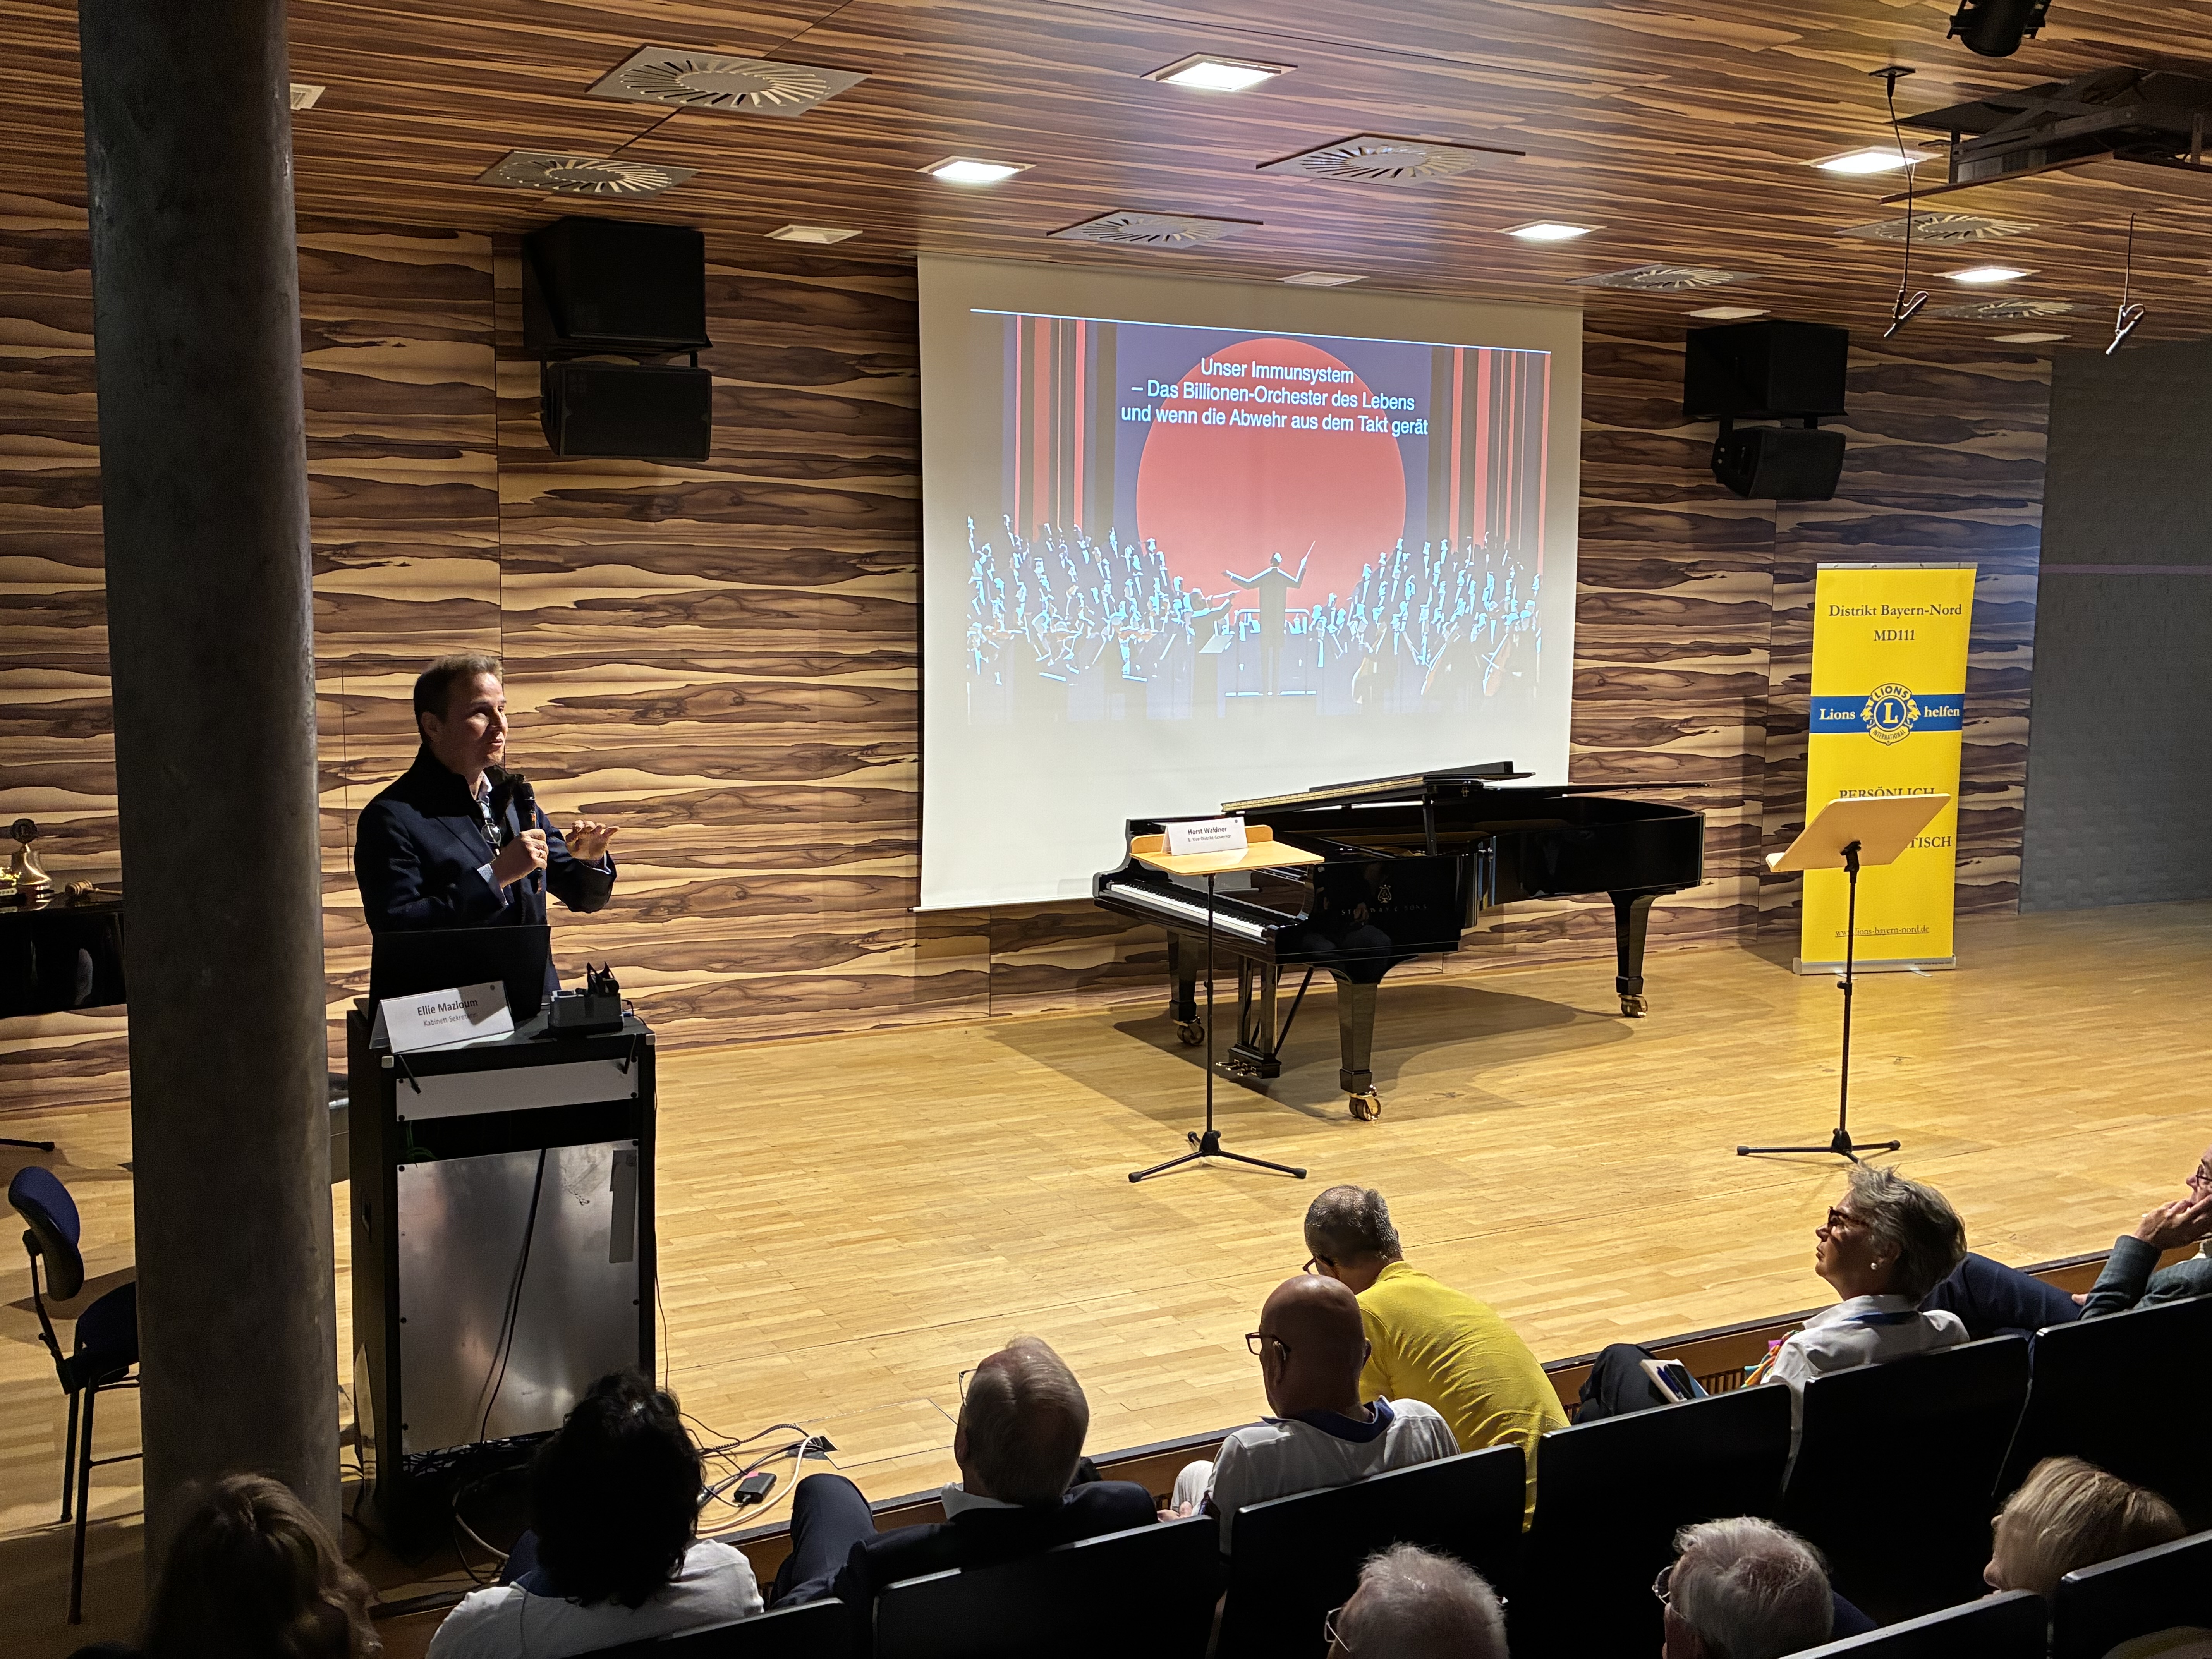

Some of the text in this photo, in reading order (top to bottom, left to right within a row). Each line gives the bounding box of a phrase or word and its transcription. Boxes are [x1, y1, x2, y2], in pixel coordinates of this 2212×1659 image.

[1201, 357, 1354, 385] Unser Immunsystem
[1147, 380, 1179, 398] Das
[1183, 381, 1328, 406] Billionen-Orchester
[1331, 390, 1358, 407] des
[1362, 392, 1415, 411] Lebens
[1121, 404, 1429, 437] und wenn die Abwehr aus dem Takt gerät
[1829, 604, 1962, 619] Distrikt Bayern-Nord
[1874, 629, 1915, 641] MD111
[1874, 685, 1909, 697] LIONS
[1819, 706, 1960, 720] Lions helfen
[1883, 702, 1898, 723] L
[1872, 729, 1906, 740] INTERNATIONAL
[1839, 786, 1935, 799] PERSÖNLICH
[1907, 836, 1951, 848] TISCH
[1835, 925, 1929, 936] wwlions-bayern-nord.de
[417, 1000, 478, 1016] Ellie Mazloum
